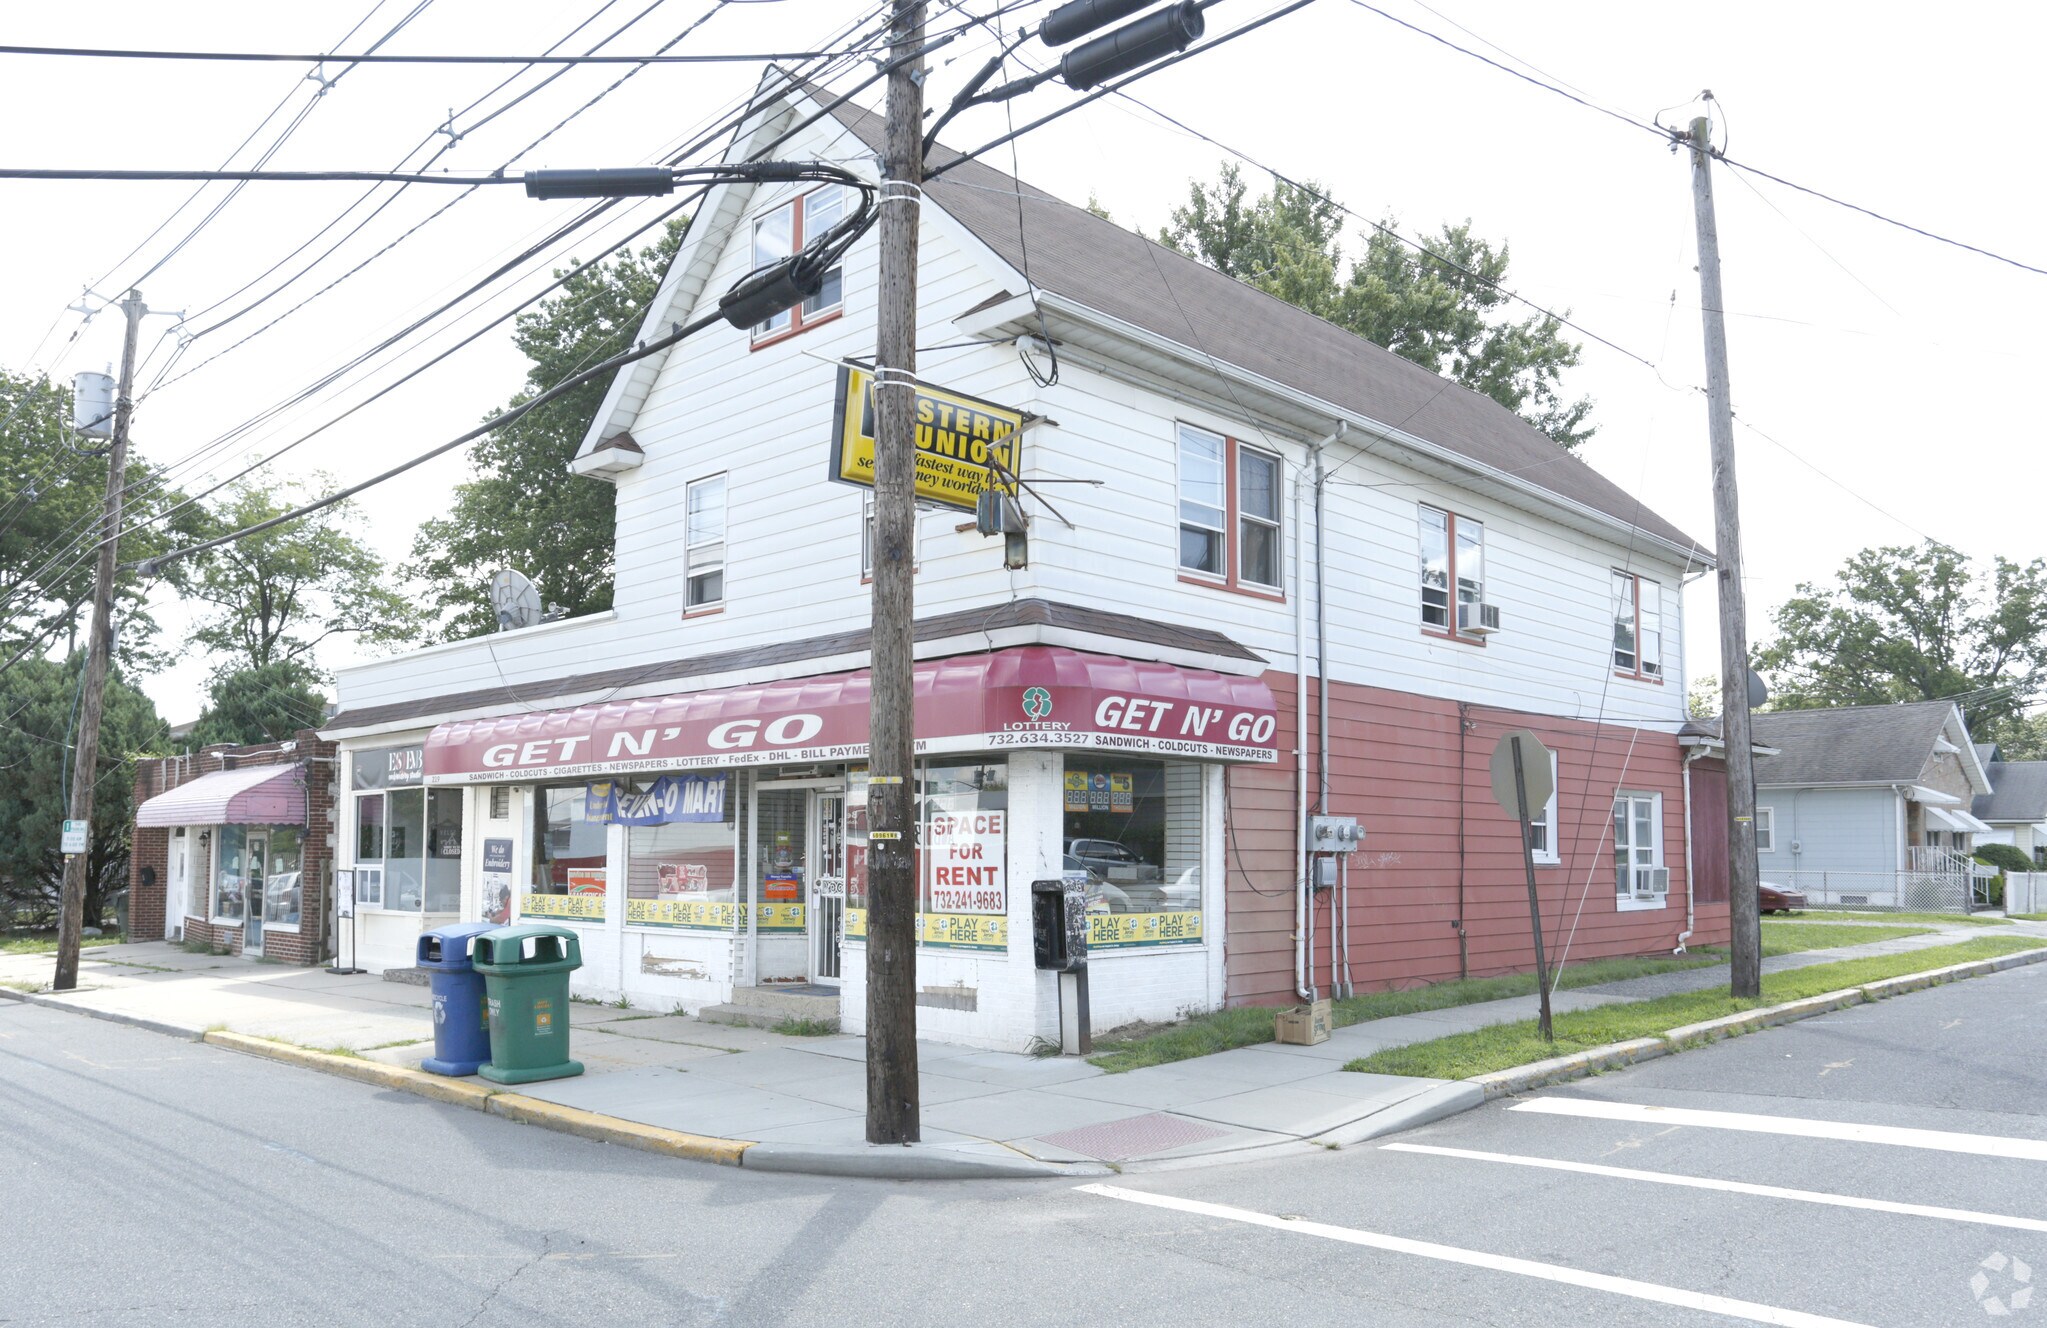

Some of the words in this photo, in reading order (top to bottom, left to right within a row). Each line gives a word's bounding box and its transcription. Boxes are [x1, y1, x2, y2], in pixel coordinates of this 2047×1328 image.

[915, 423, 1009, 469] UNION
[915, 453, 953, 475] fastest
[957, 467, 983, 482] way
[915, 470, 939, 488] ney
[1094, 696, 1174, 732] GET
[1228, 712, 1276, 743] GO
[1003, 722, 1071, 731] LOTTERY
[482, 735, 590, 767] GET
[707, 714, 823, 749] GO
[989, 733, 1089, 745] 732.634.3527
[1095, 735, 1150, 749] SANDWICH
[1158, 740, 1208, 754] COLDCUTS
[1216, 745, 1273, 760] NEWSPAPERS
[469, 772, 504, 781] SANDWICH
[510, 769, 547, 778] COLDCUTS
[554, 763, 602, 775] CIGARETTES
[609, 759, 668, 771] NEWSPAPERS
[676, 756, 719, 767] LOTTERY
[729, 753, 759, 764] FedEx
[769, 751, 791, 761] DHL
[801, 748, 826, 759] BILL
[682, 780, 726, 814] MART
[934, 815, 1001, 835] SPACE
[950, 843, 983, 859] FOR
[485, 857, 510, 869] Embroidery
[936, 866, 998, 886] RENT
[531, 896, 546, 904] PLAY
[568, 898, 583, 906] PLAY
[628, 901, 645, 910] PLAY
[934, 890, 1002, 910] 732-241-9683
[531, 904, 545, 913] HERE
[568, 906, 583, 915] HERE
[673, 903, 692, 912] PLAY
[628, 911, 645, 919] HERE
[673, 913, 692, 922] HERE
[1159, 915, 1183, 926] PLAY
[950, 917, 978, 929] PLAY
[1093, 918, 1120, 929] PLAY
[950, 929, 978, 941] HERE
[1093, 929, 1120, 941] HERE
[1159, 926, 1183, 937] HERE
